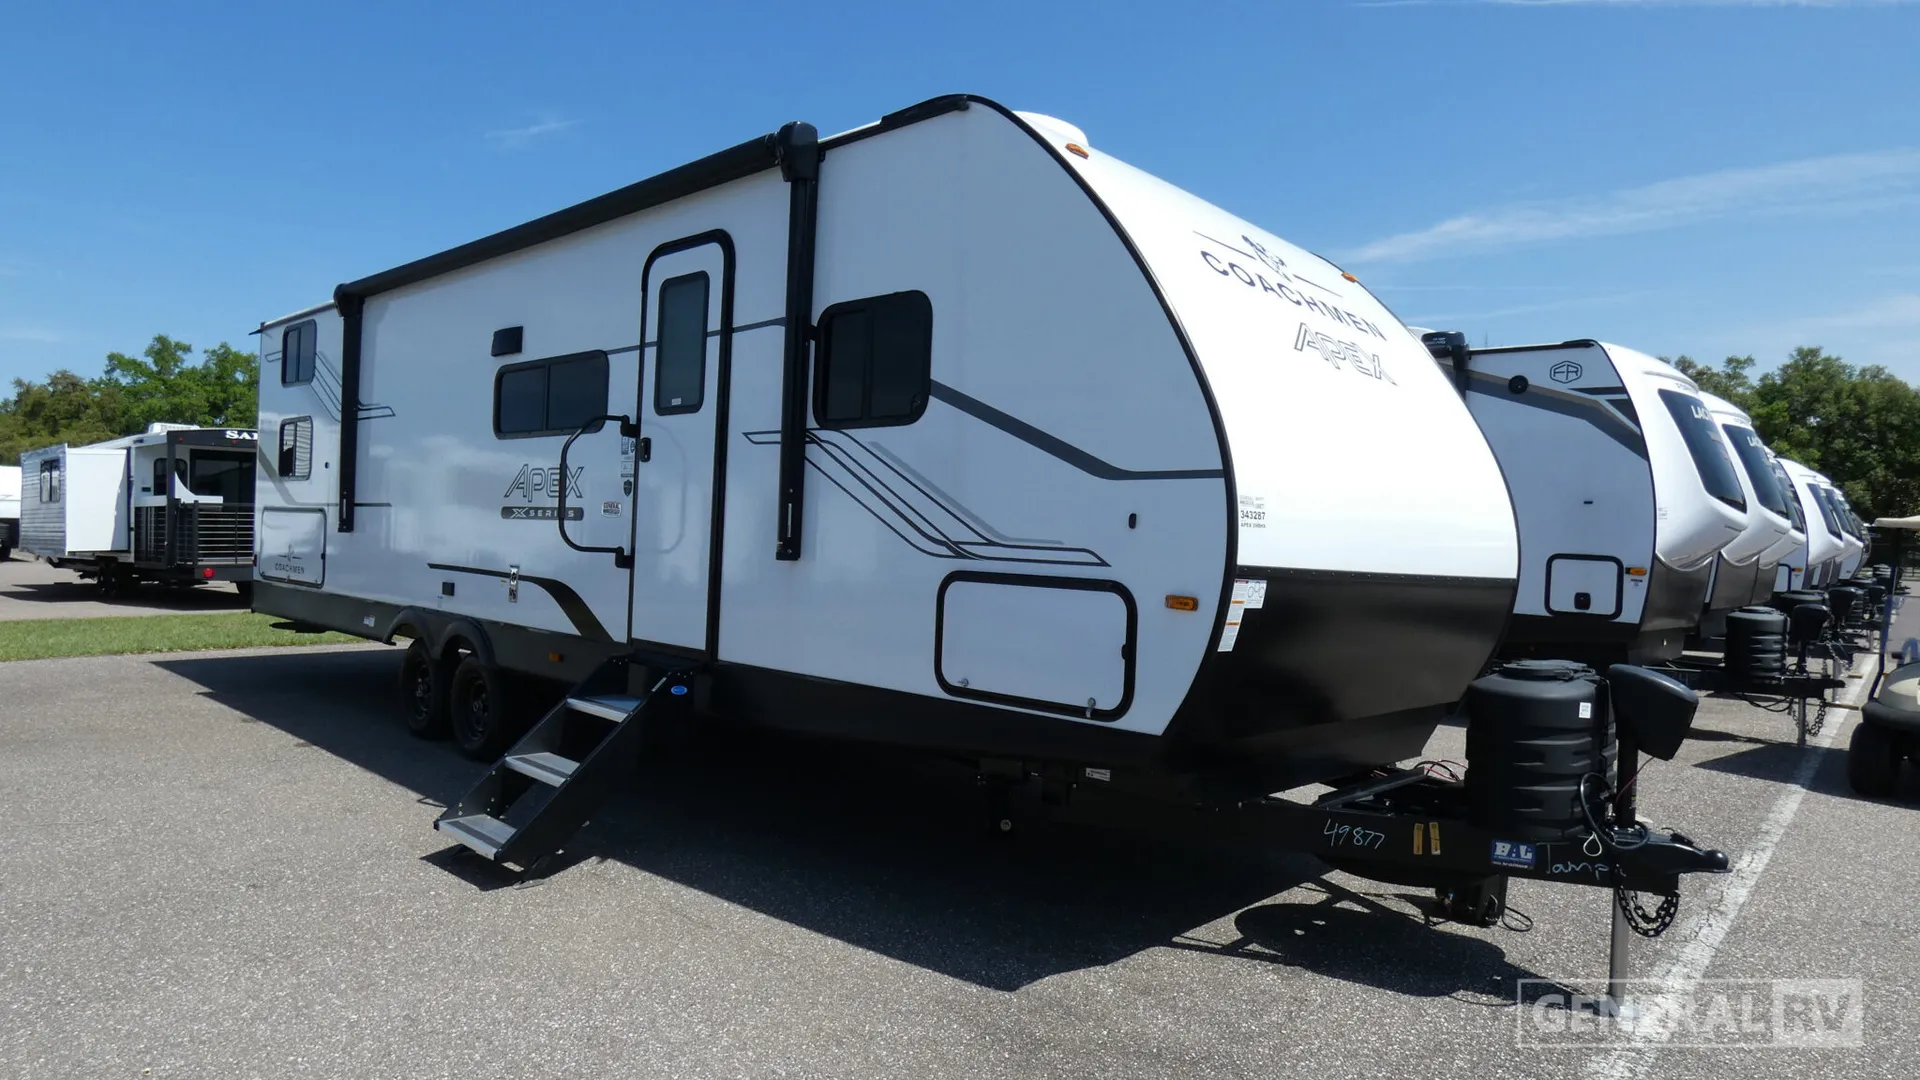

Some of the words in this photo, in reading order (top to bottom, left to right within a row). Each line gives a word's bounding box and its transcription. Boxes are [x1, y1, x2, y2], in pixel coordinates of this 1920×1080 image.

[1200, 250, 1388, 342] COACHMEN
[1294, 322, 1398, 386] APEX
[504, 463, 584, 503] APEX
[1240, 510, 1266, 520] 343287
[274, 562, 305, 574] COACHMEN
[1323, 818, 1385, 850] 49877
